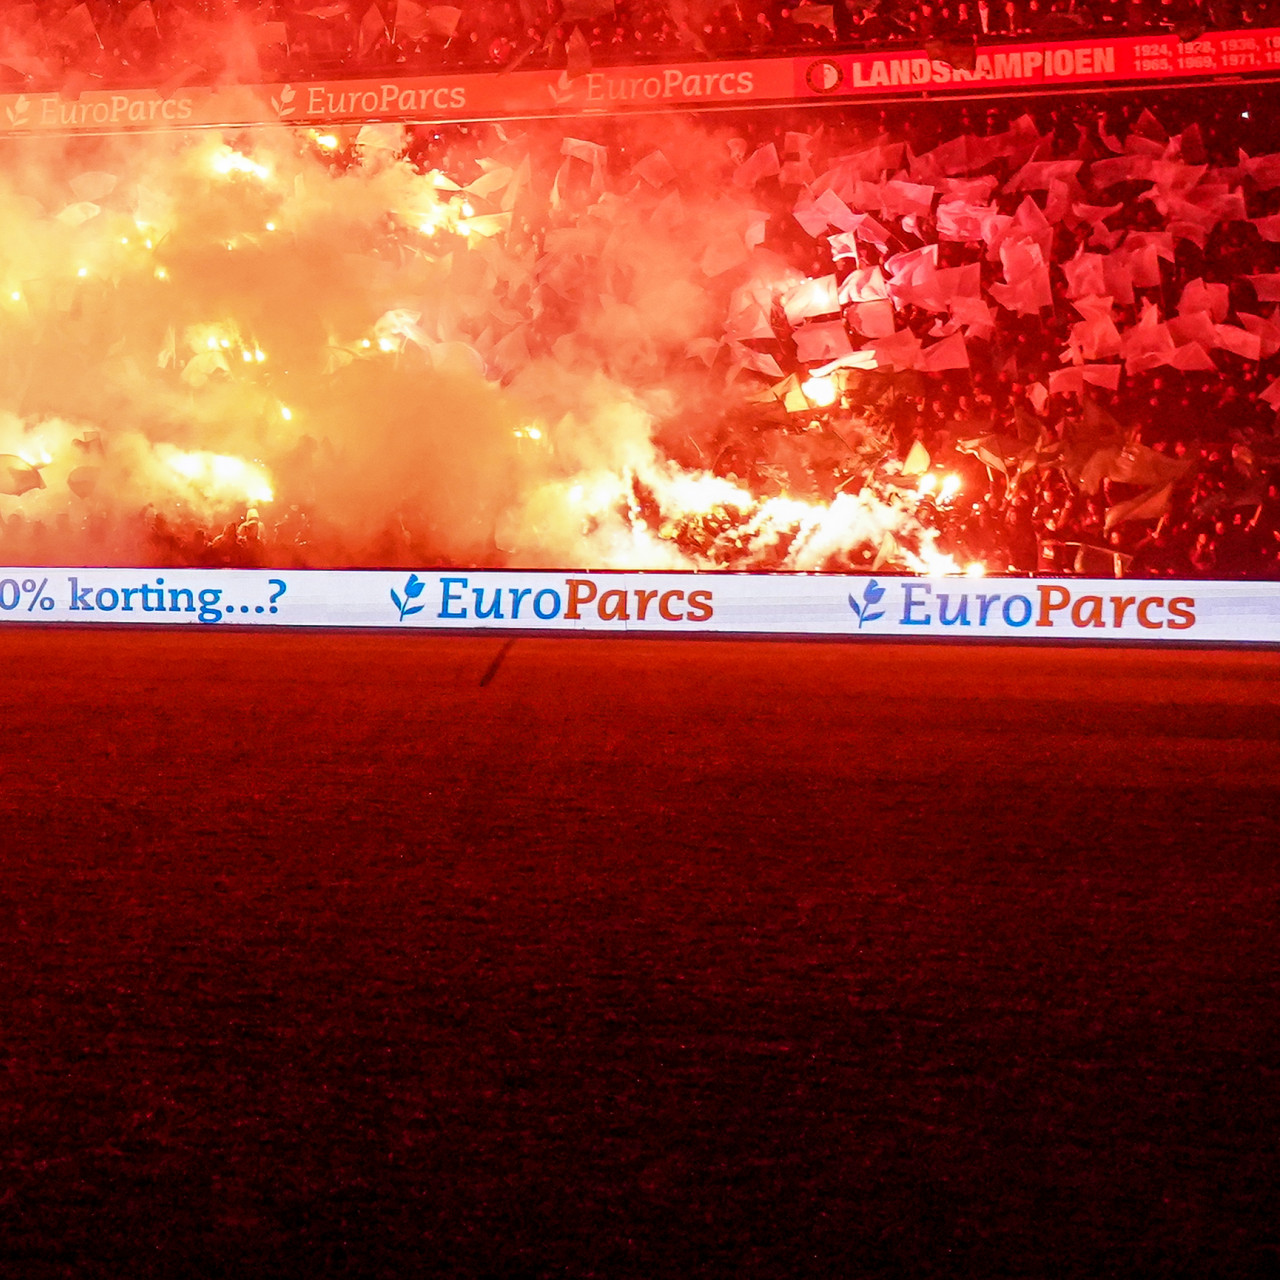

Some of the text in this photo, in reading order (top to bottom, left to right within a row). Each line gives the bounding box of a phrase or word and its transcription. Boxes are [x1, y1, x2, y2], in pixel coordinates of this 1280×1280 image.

[306, 83, 466, 116] EuroParcs
[585, 70, 754, 103] EuroParcs
[41, 94, 193, 126] EuroParcs
[69, 577, 288, 623] korting...?
[438, 577, 713, 622] EuroParcs
[900, 581, 1197, 630] EuroParcs
